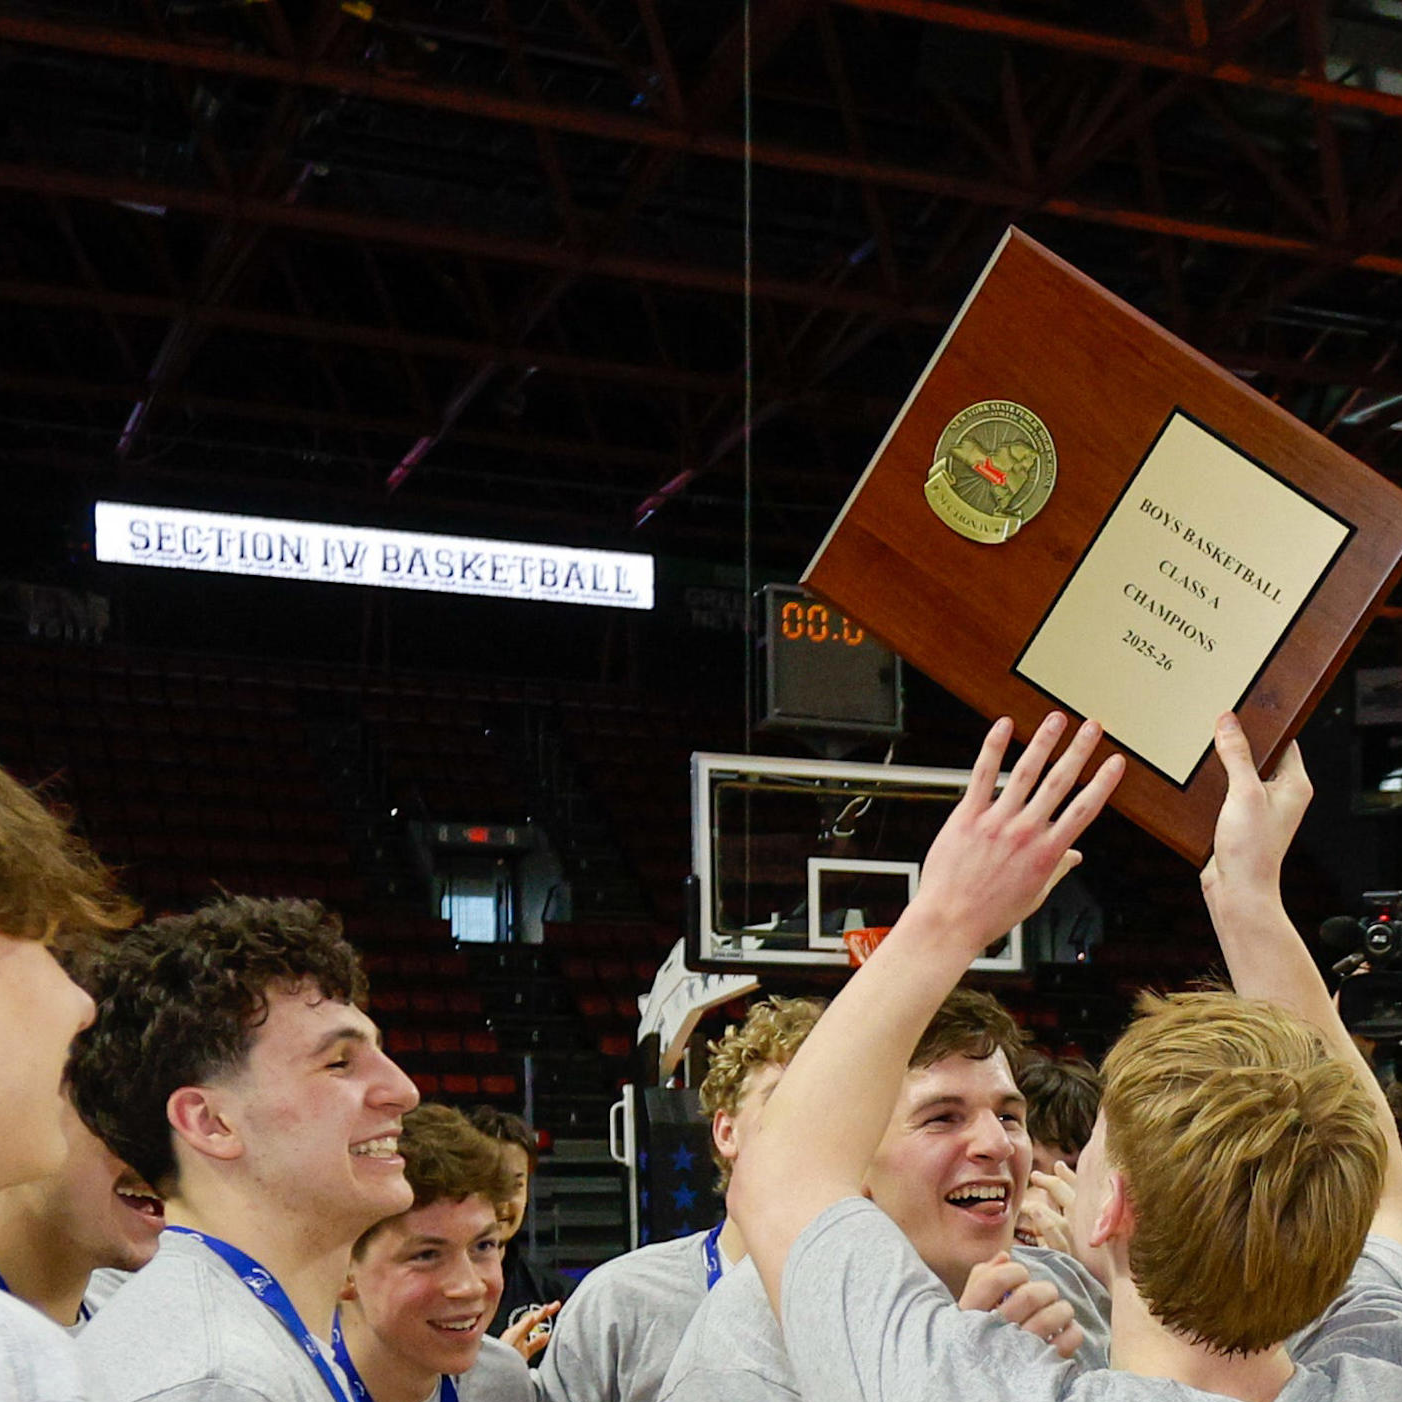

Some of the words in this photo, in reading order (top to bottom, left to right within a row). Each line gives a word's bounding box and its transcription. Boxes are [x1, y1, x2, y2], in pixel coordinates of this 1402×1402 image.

[129, 518, 306, 568] SECTION
[321, 538, 366, 574] IV
[381, 543, 636, 597] BASKETBALL
[1139, 498, 1183, 534] BOYS
[1182, 527, 1283, 605] BASKETBALL
[1158, 559, 1209, 600] CLASS
[1207, 596, 1220, 610] A
[1121, 629, 1174, 672] 2025-26
[1123, 583, 1217, 653] CHAMPIONS
